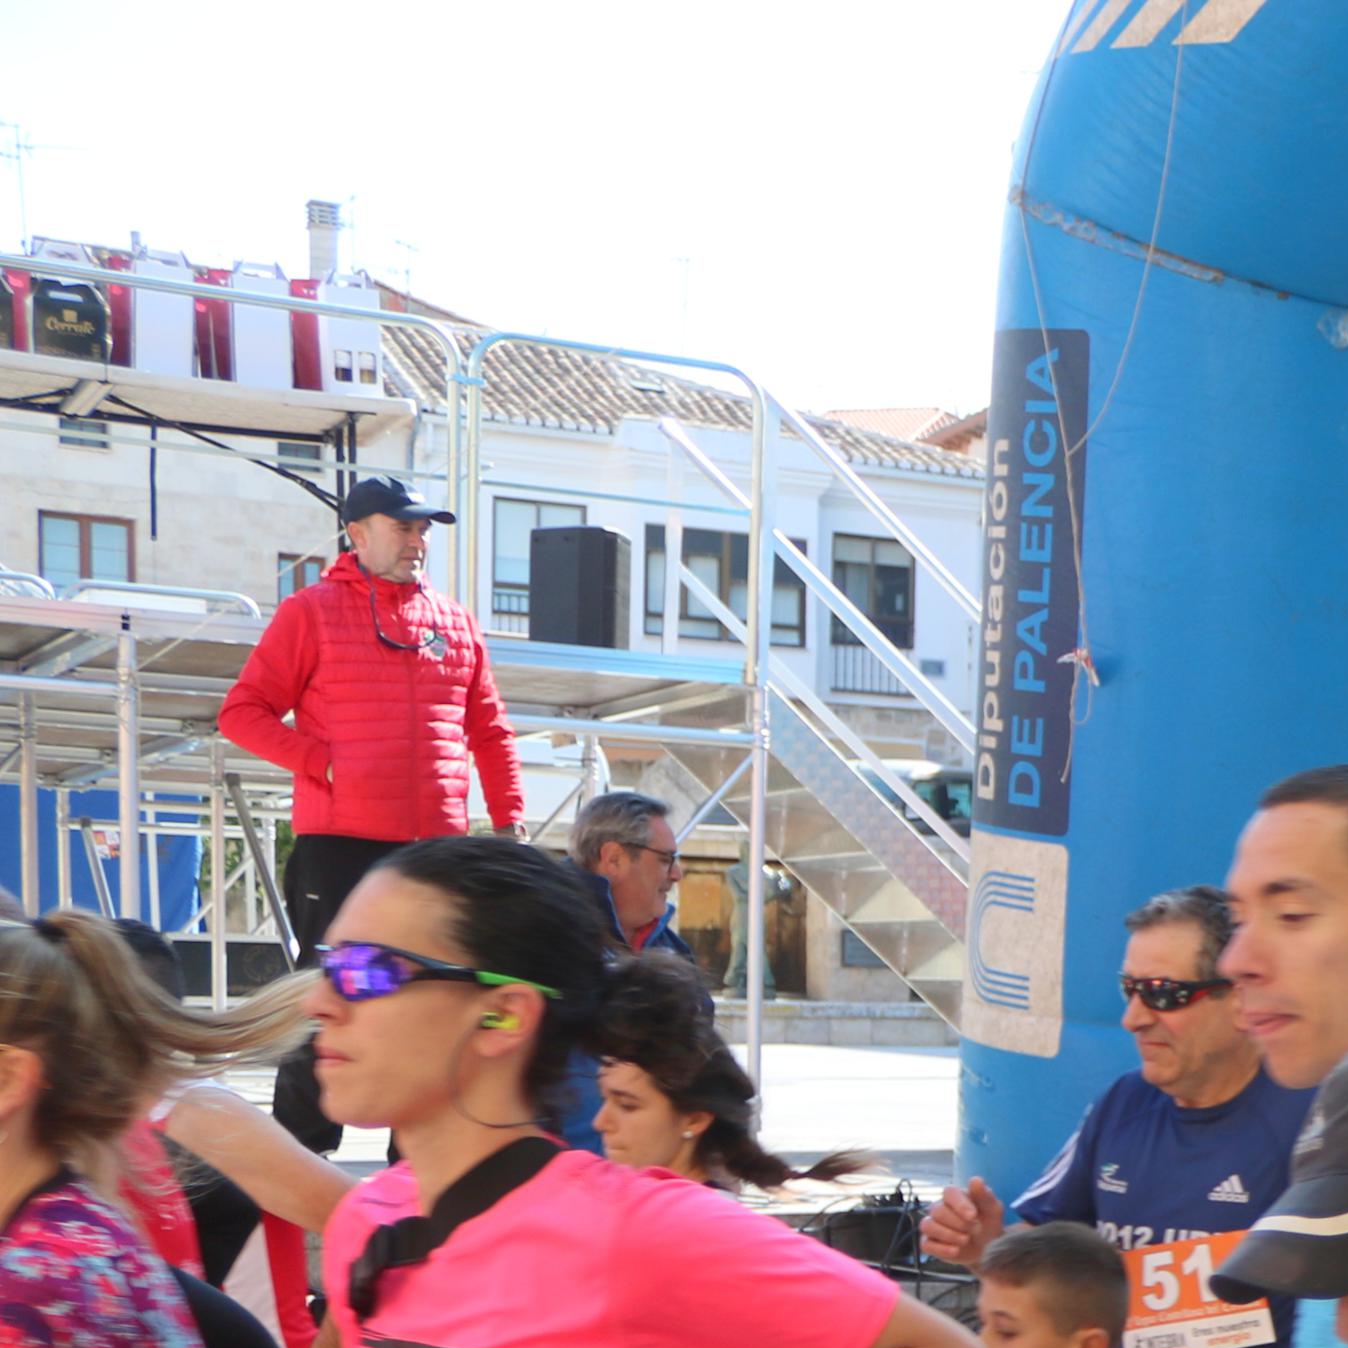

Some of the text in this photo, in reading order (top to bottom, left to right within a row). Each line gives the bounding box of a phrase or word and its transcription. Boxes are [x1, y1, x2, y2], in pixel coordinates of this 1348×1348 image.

[977, 438, 1010, 802] Diputación
[1007, 347, 1060, 810] DE PALENCIA
[1097, 1220, 1153, 1250] 012
